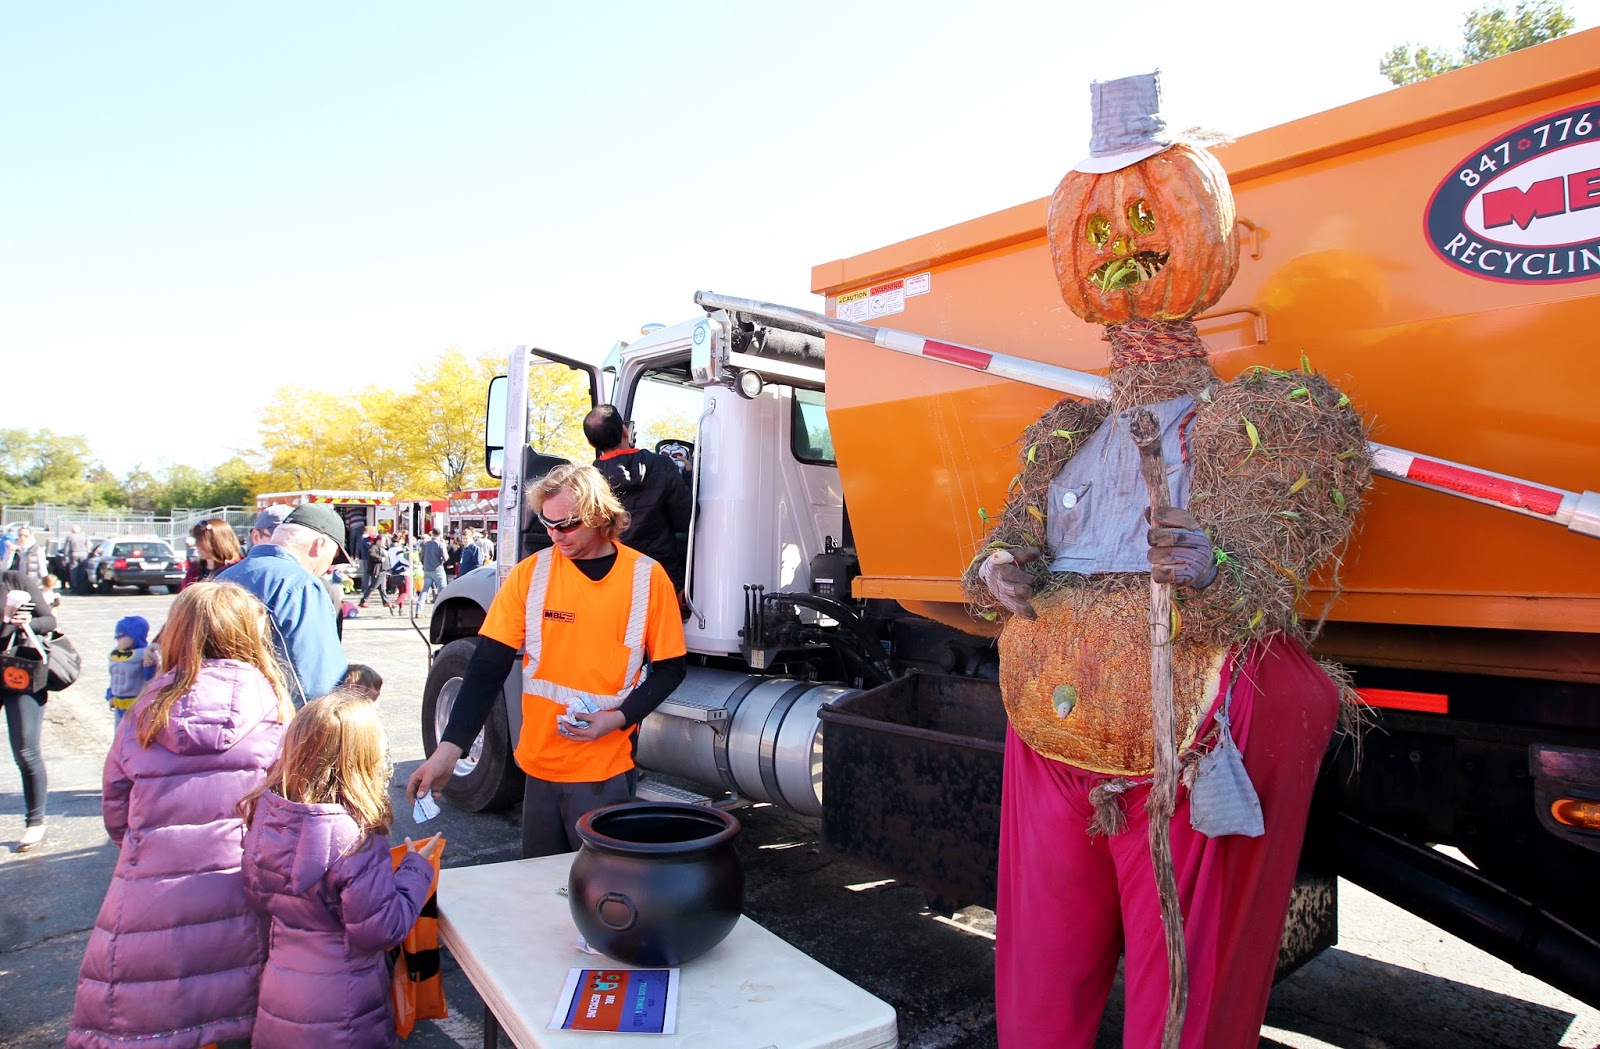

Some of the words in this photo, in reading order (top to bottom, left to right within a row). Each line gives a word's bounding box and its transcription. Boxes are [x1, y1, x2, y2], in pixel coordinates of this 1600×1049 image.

[1459, 141, 1511, 187] 847
[1533, 112, 1593, 149] 776
[1444, 232, 1600, 275] RECYCLIN
[842, 291, 868, 303] CAUTION
[875, 281, 903, 294] WARNING
[544, 611, 566, 620] MBL
[586, 993, 601, 1018] RECYCLING
